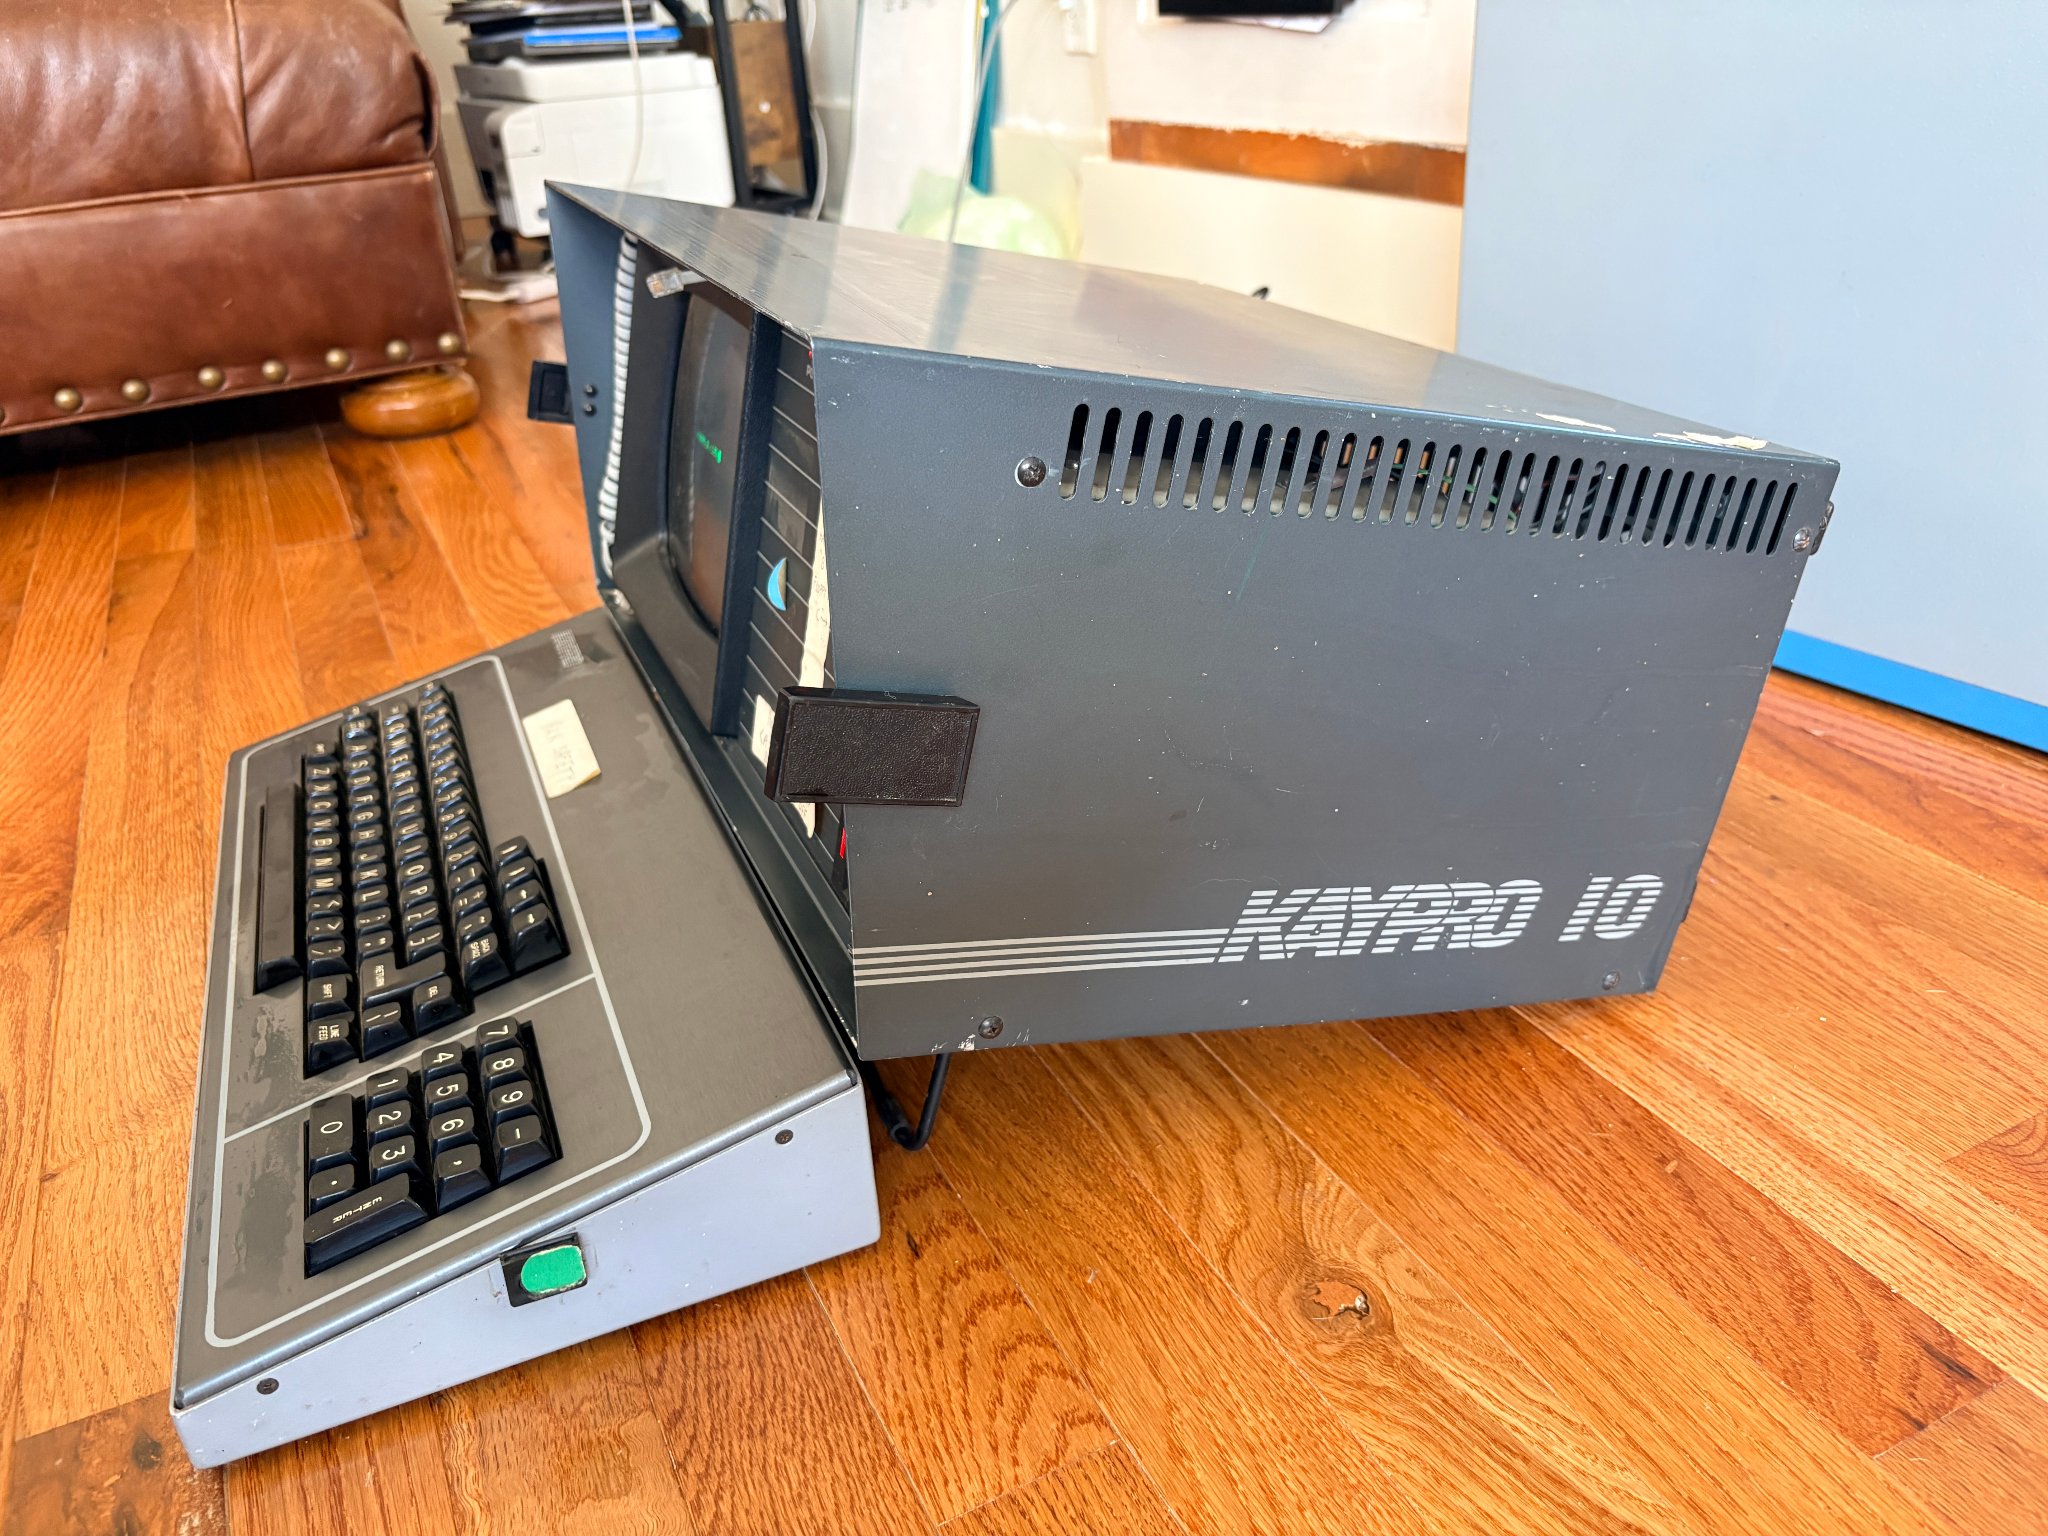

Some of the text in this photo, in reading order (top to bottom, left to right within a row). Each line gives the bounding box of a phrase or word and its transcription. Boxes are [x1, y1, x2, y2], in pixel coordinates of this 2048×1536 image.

[396, 786, 414, 797] T
[314, 801, 331, 809] C
[399, 804, 416, 815] Y
[357, 811, 374, 820] G
[358, 829, 376, 839] H
[402, 823, 419, 834] U
[314, 837, 333, 846] B
[314, 857, 334, 867] N
[360, 869, 379, 880] K
[407, 864, 424, 876] O
[315, 877, 334, 889] M
[362, 890, 381, 902] L
[410, 885, 427, 895] P
[1218, 873, 1665, 963] KAYPRO 10
[374, 964, 385, 988] RETURN
[322, 983, 333, 999] SHIFT
[428, 985, 439, 998] DEL
[317, 1025, 329, 1041] FEED
[329, 1024, 341, 1039] LINE
[486, 1024, 510, 1037] 7
[431, 1052, 455, 1063] 4
[492, 1057, 516, 1071] 8
[376, 1077, 400, 1088] 1
[436, 1084, 460, 1097] 5
[501, 1090, 524, 1104] 9
[378, 1110, 402, 1126] 2
[320, 1120, 344, 1135] 0
[441, 1118, 465, 1132] 6
[381, 1144, 406, 1161] 3
[332, 1195, 383, 1224] ENTER
